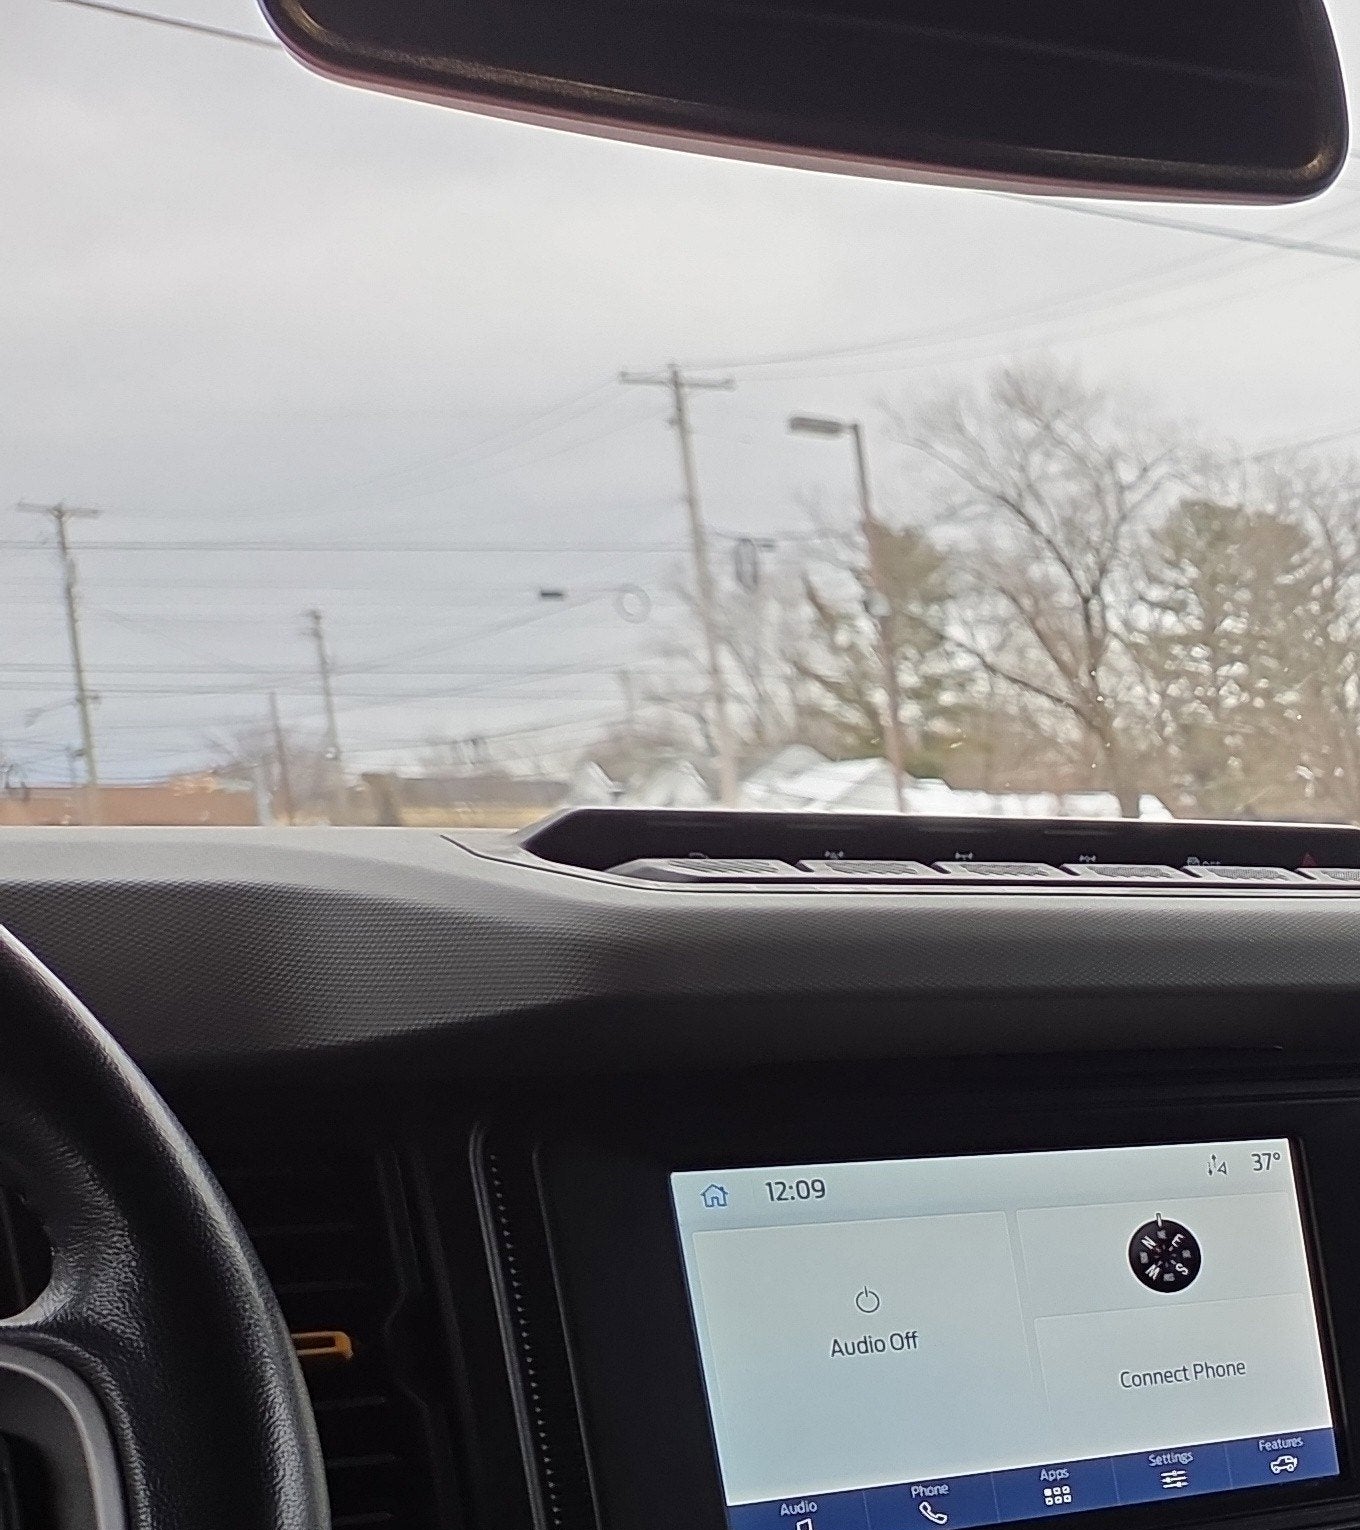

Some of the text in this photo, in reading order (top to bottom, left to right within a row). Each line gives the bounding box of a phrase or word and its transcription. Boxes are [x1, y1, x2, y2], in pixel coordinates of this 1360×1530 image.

[765, 1179, 826, 1202] 12:09
[829, 1330, 919, 1359] Audio Off
[1119, 1360, 1247, 1390] Connect Phone
[1258, 1436, 1304, 1452] Features
[1149, 1449, 1195, 1469] Settings
[1040, 1465, 1070, 1484] Apps
[911, 1481, 950, 1499] Phone
[780, 1500, 818, 1516] Audio
